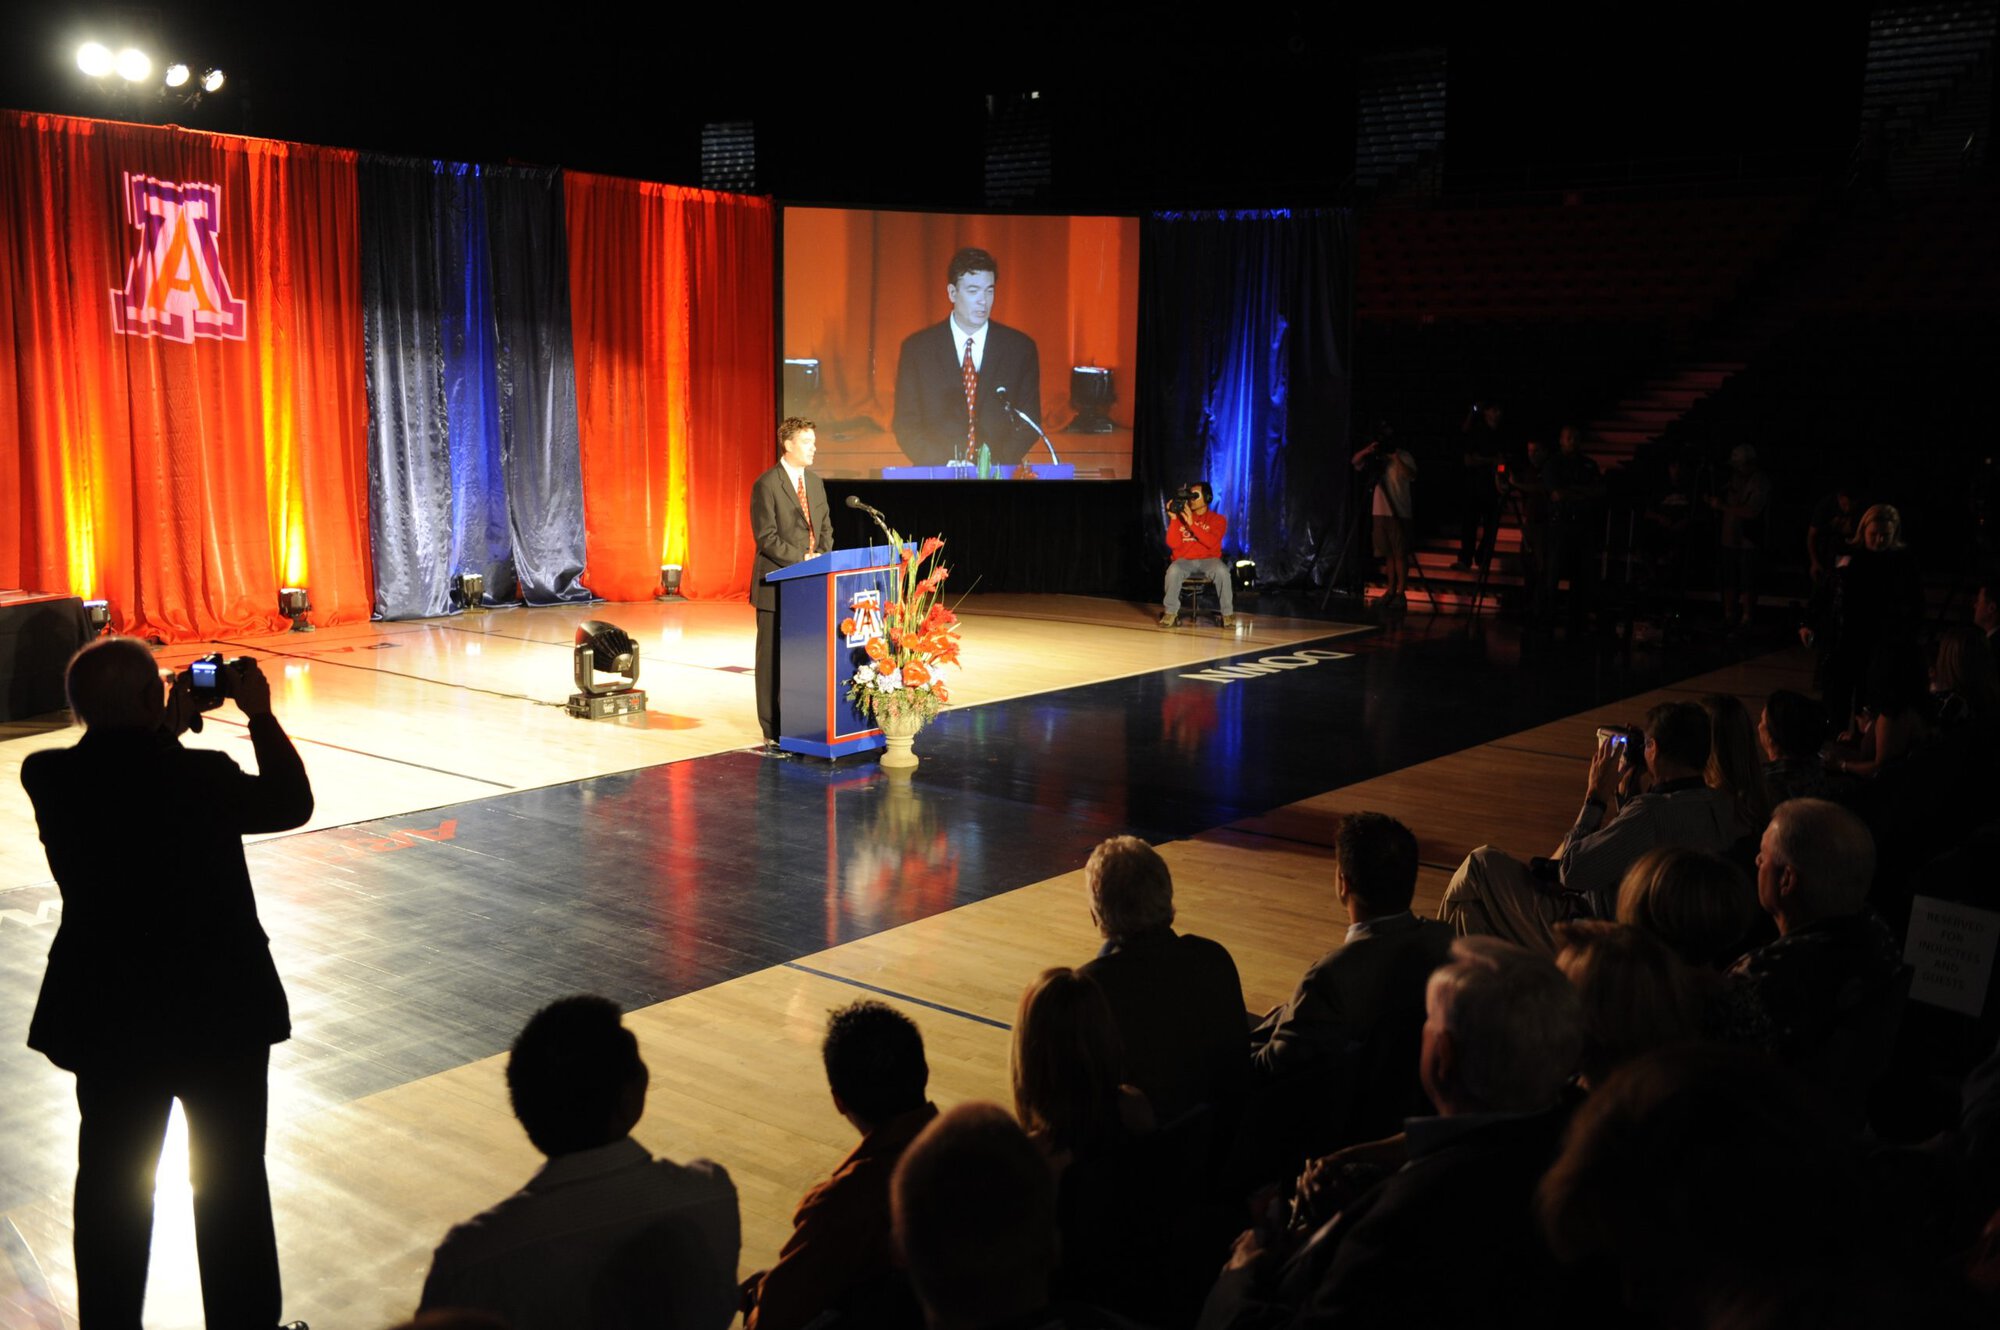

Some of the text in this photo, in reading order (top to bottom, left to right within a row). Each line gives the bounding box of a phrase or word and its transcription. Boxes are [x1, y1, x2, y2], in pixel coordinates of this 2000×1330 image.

[110, 171, 247, 344] A
[1178, 649, 1355, 684] DOWN
[1927, 912, 1983, 932] RESERVED
[1940, 930, 1964, 943] FOR
[1919, 941, 1980, 963] INDUCTEES
[1934, 960, 1959, 973] AND
[1921, 971, 1965, 990] GUESTS
